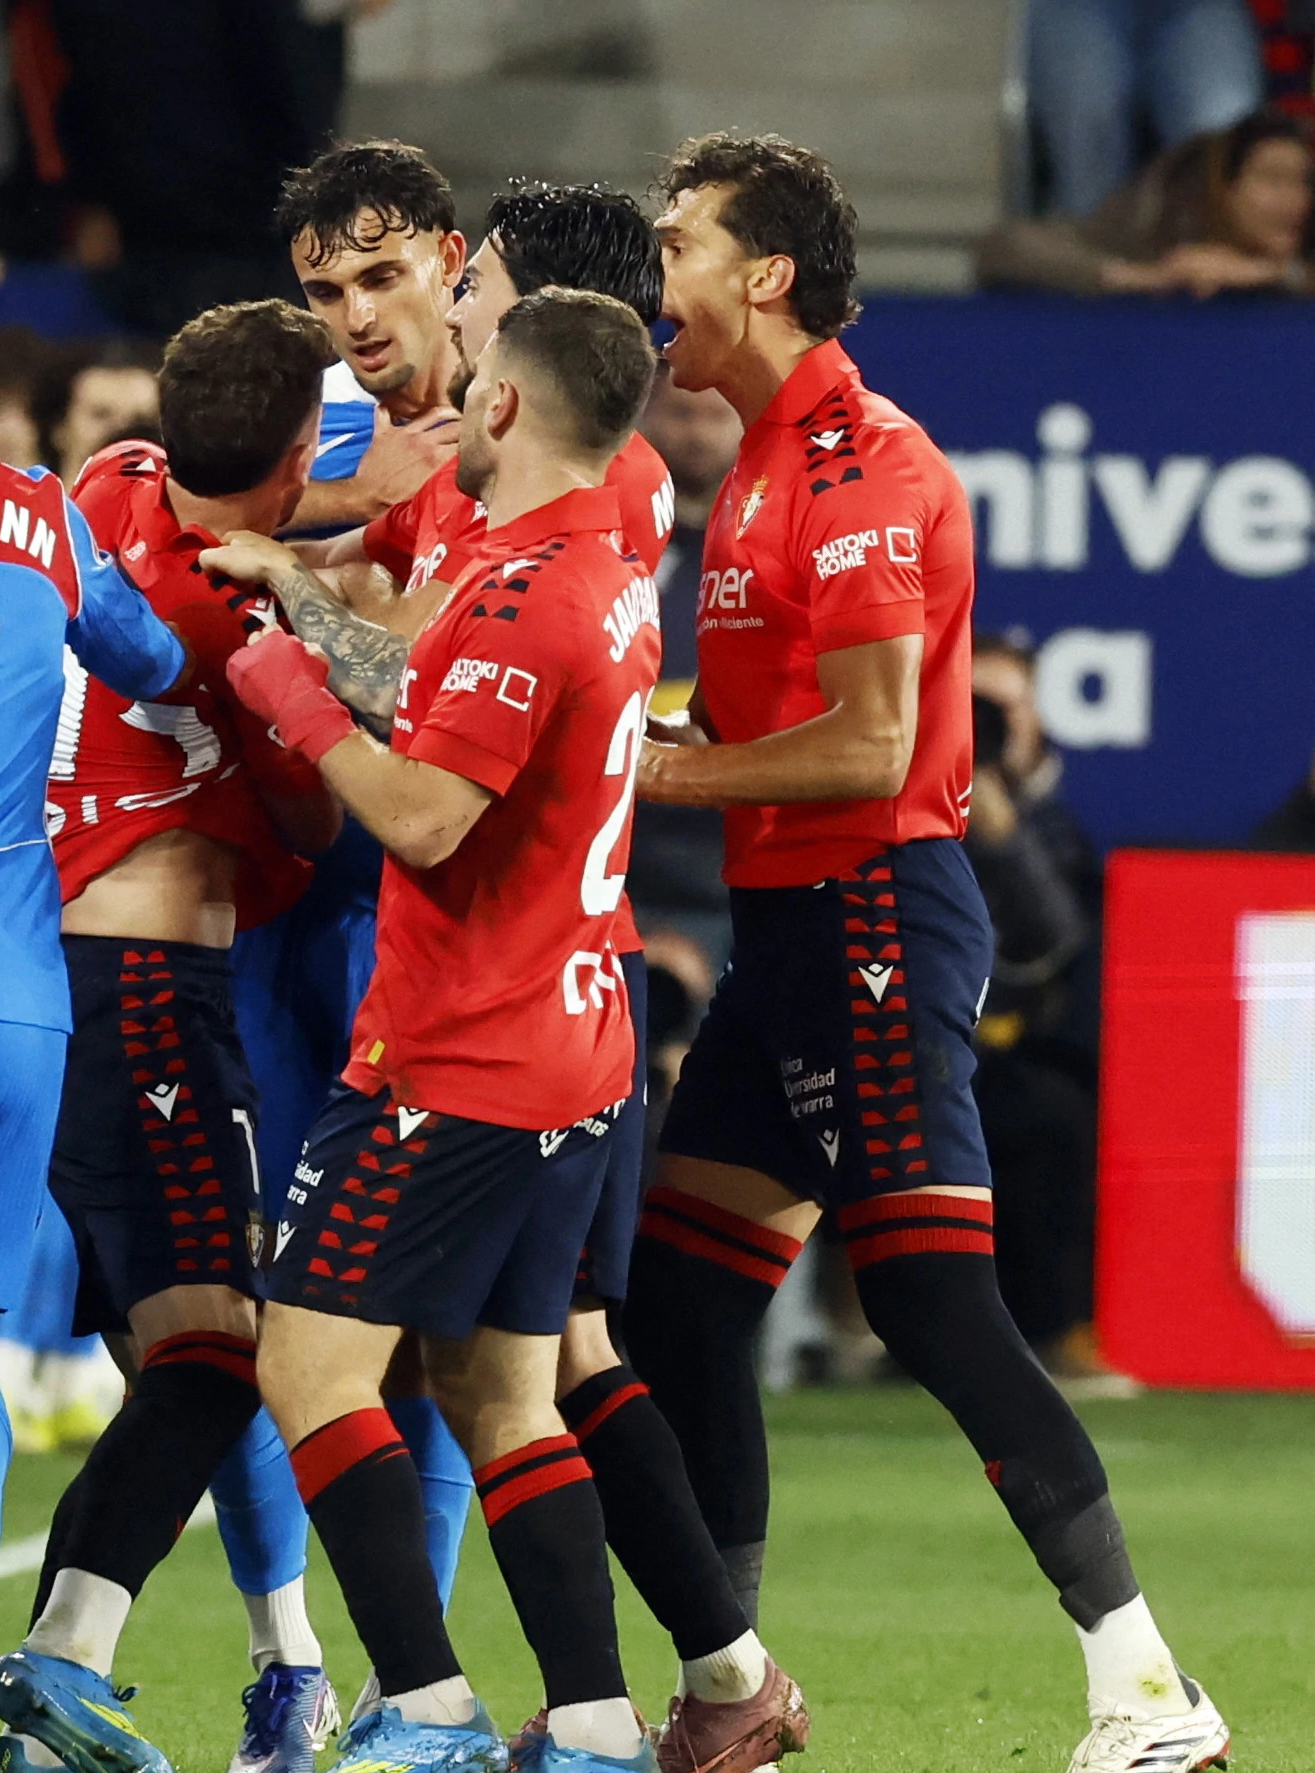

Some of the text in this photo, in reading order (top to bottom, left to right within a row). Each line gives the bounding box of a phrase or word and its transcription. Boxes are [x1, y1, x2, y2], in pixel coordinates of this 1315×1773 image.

[812, 530, 879, 560] SALTOKI
[816, 548, 867, 581] HOME
[447, 658, 499, 680] ALTOKI
